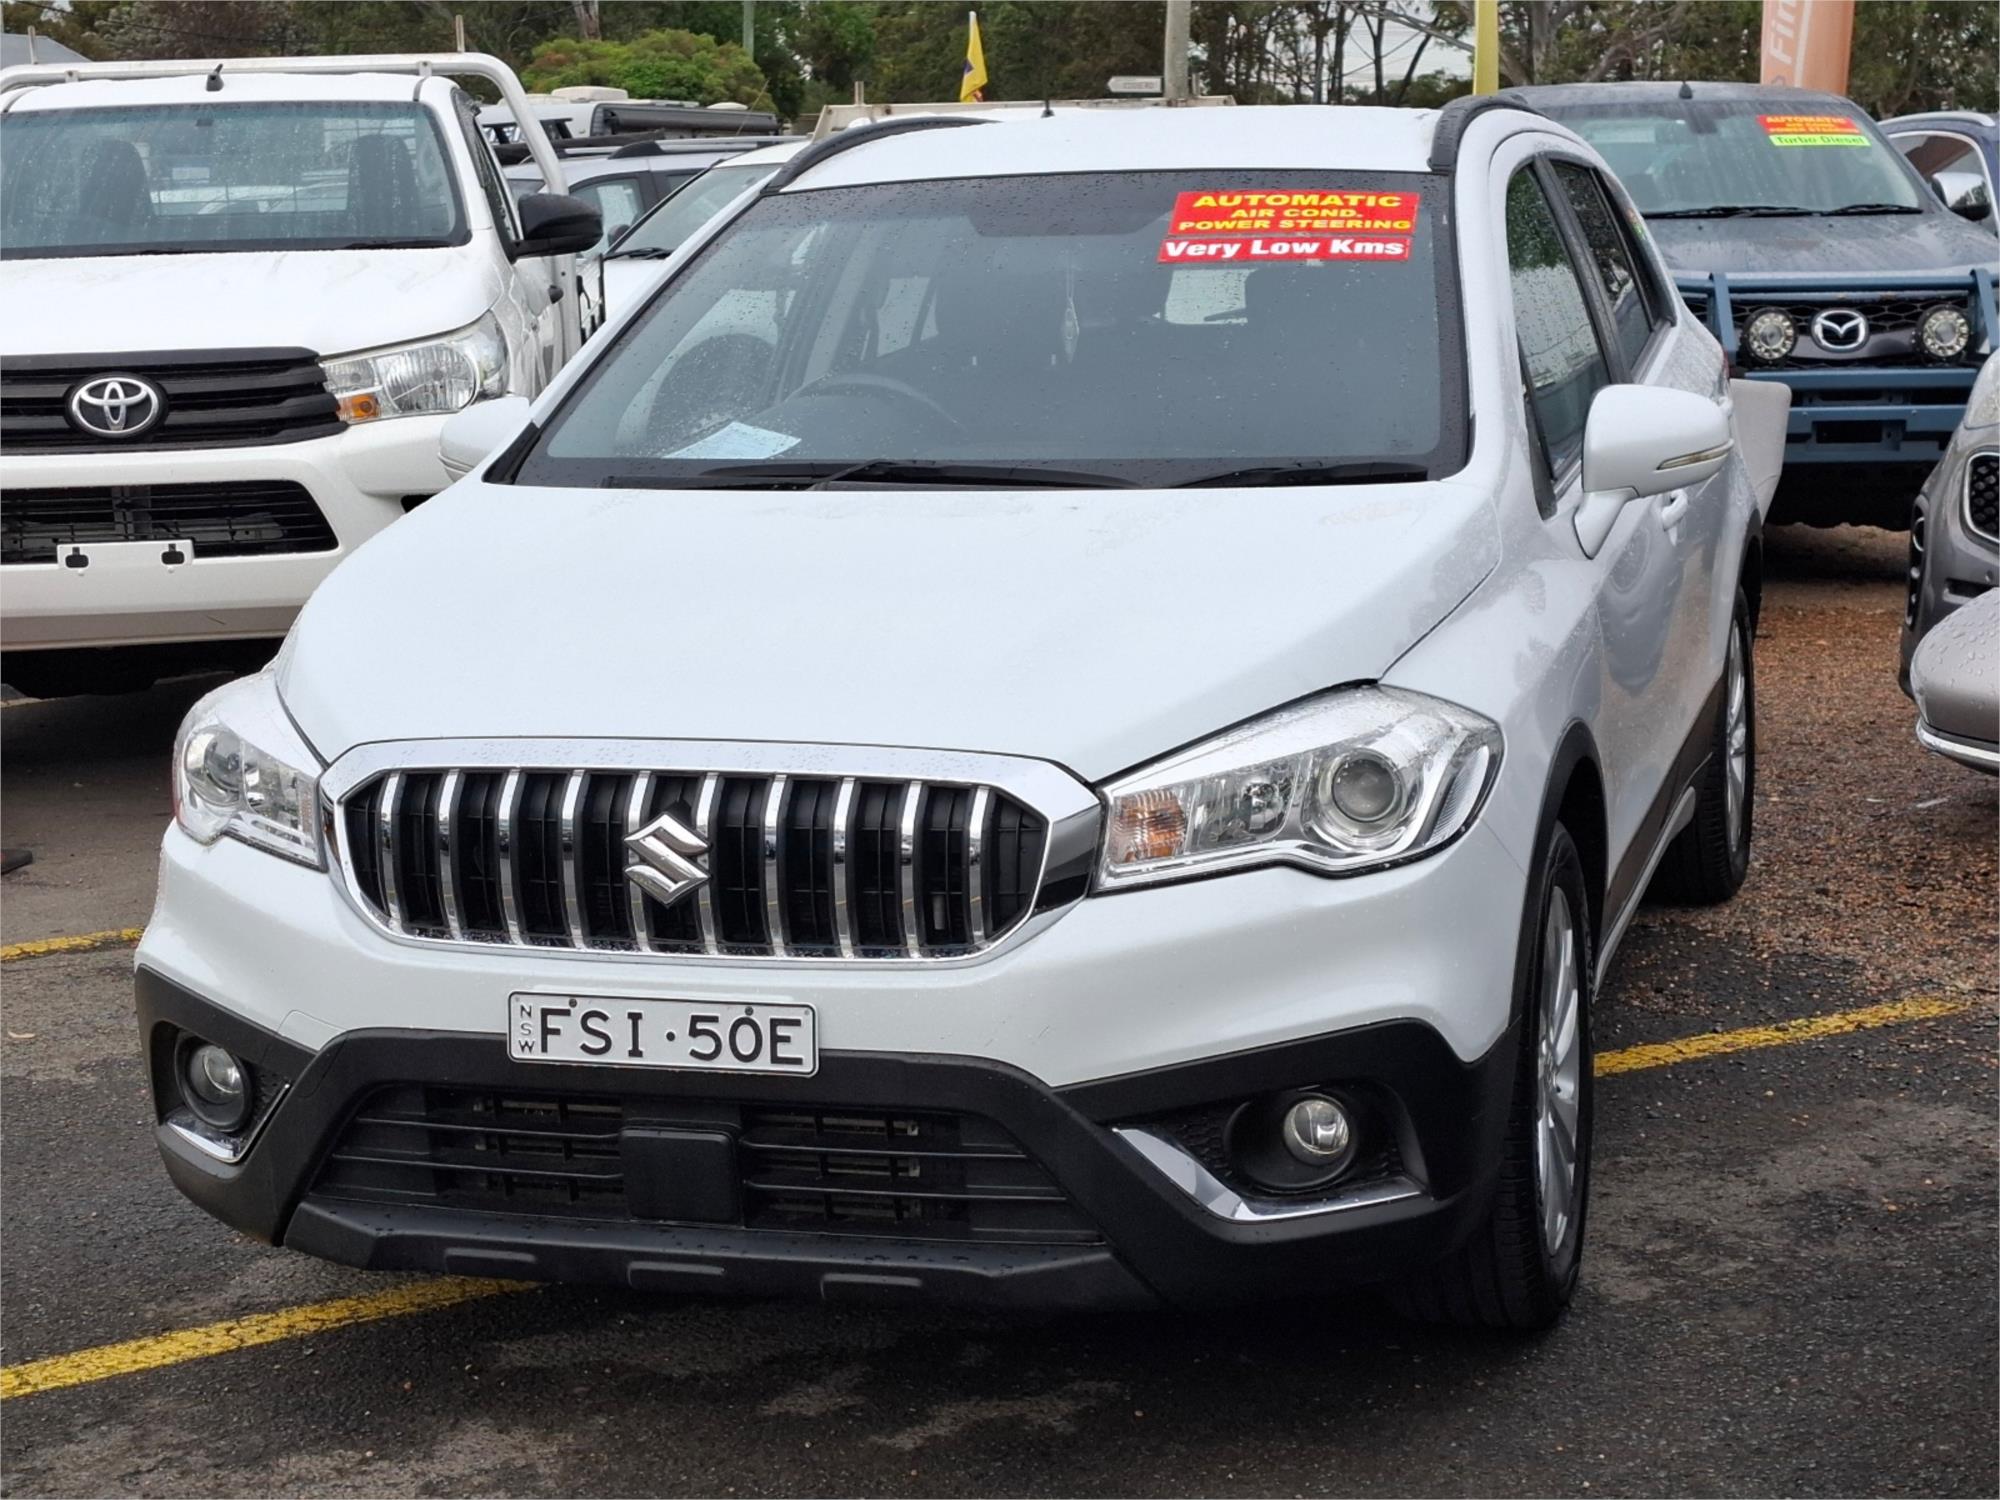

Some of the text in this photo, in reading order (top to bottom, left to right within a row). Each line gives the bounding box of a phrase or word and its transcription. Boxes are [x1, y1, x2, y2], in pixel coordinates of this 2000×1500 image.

[1776, 136, 1865, 145] Turbo Diesel
[1192, 194, 1401, 208] AUTOMATIC
[1231, 208, 1363, 218] AIR COND.
[1178, 219, 1412, 231] POWER STEERING
[1165, 238, 1405, 258] Very Low Kms
[518, 1004, 535, 1054] NSW
